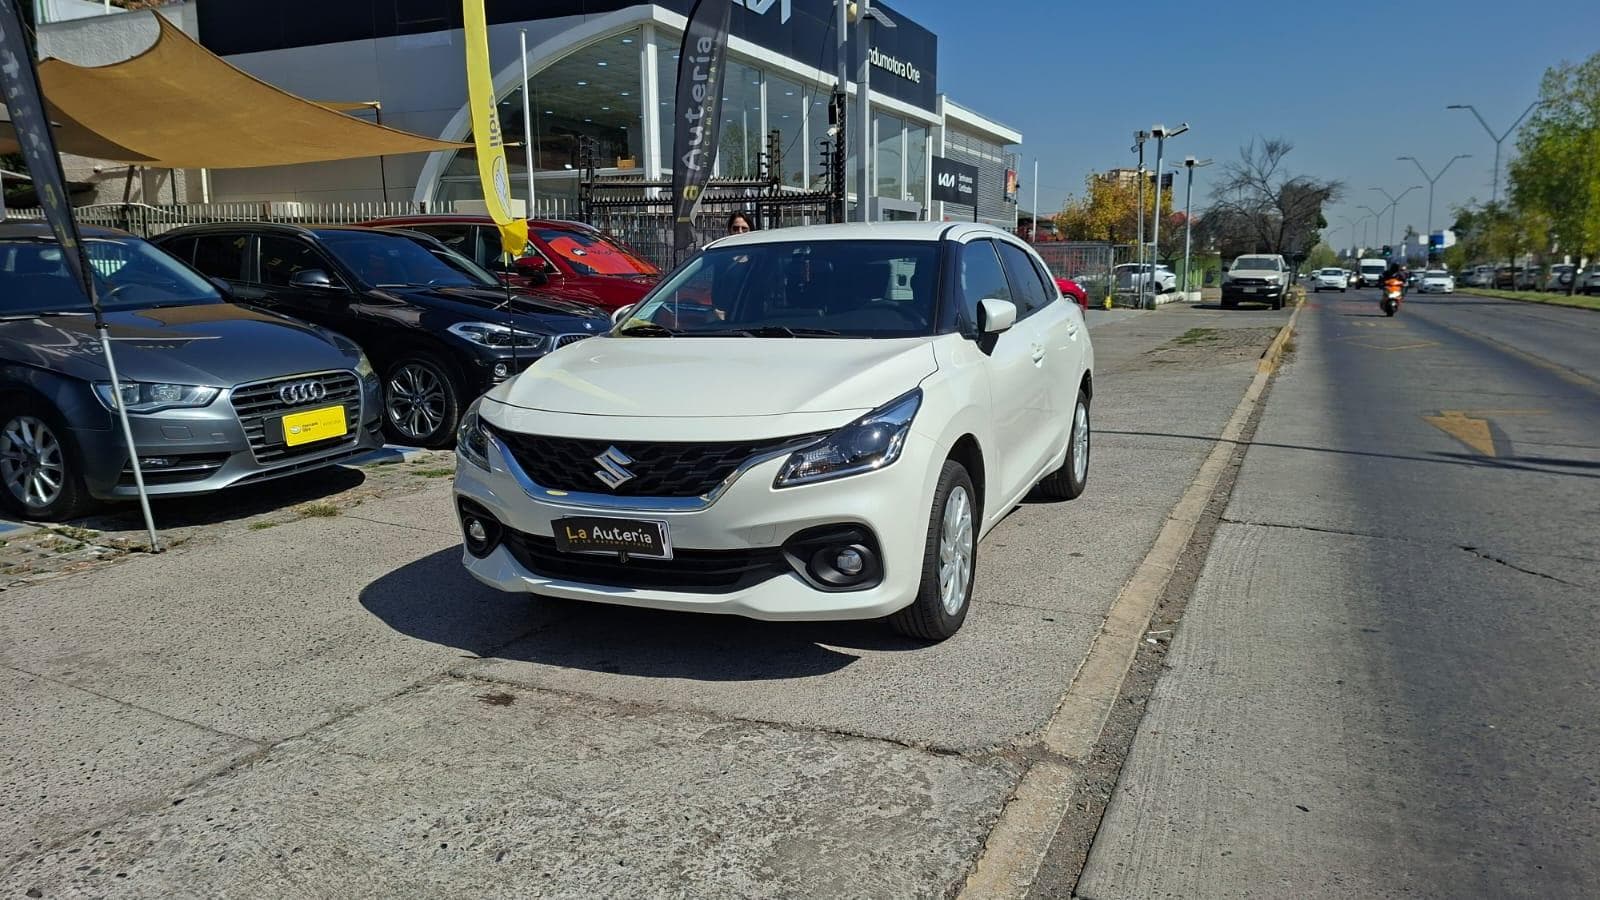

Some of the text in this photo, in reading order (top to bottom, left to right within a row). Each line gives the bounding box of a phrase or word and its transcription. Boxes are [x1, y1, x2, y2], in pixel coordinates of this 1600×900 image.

[868, 46, 920, 83] ndumotora One
[566, 526, 588, 540] La
